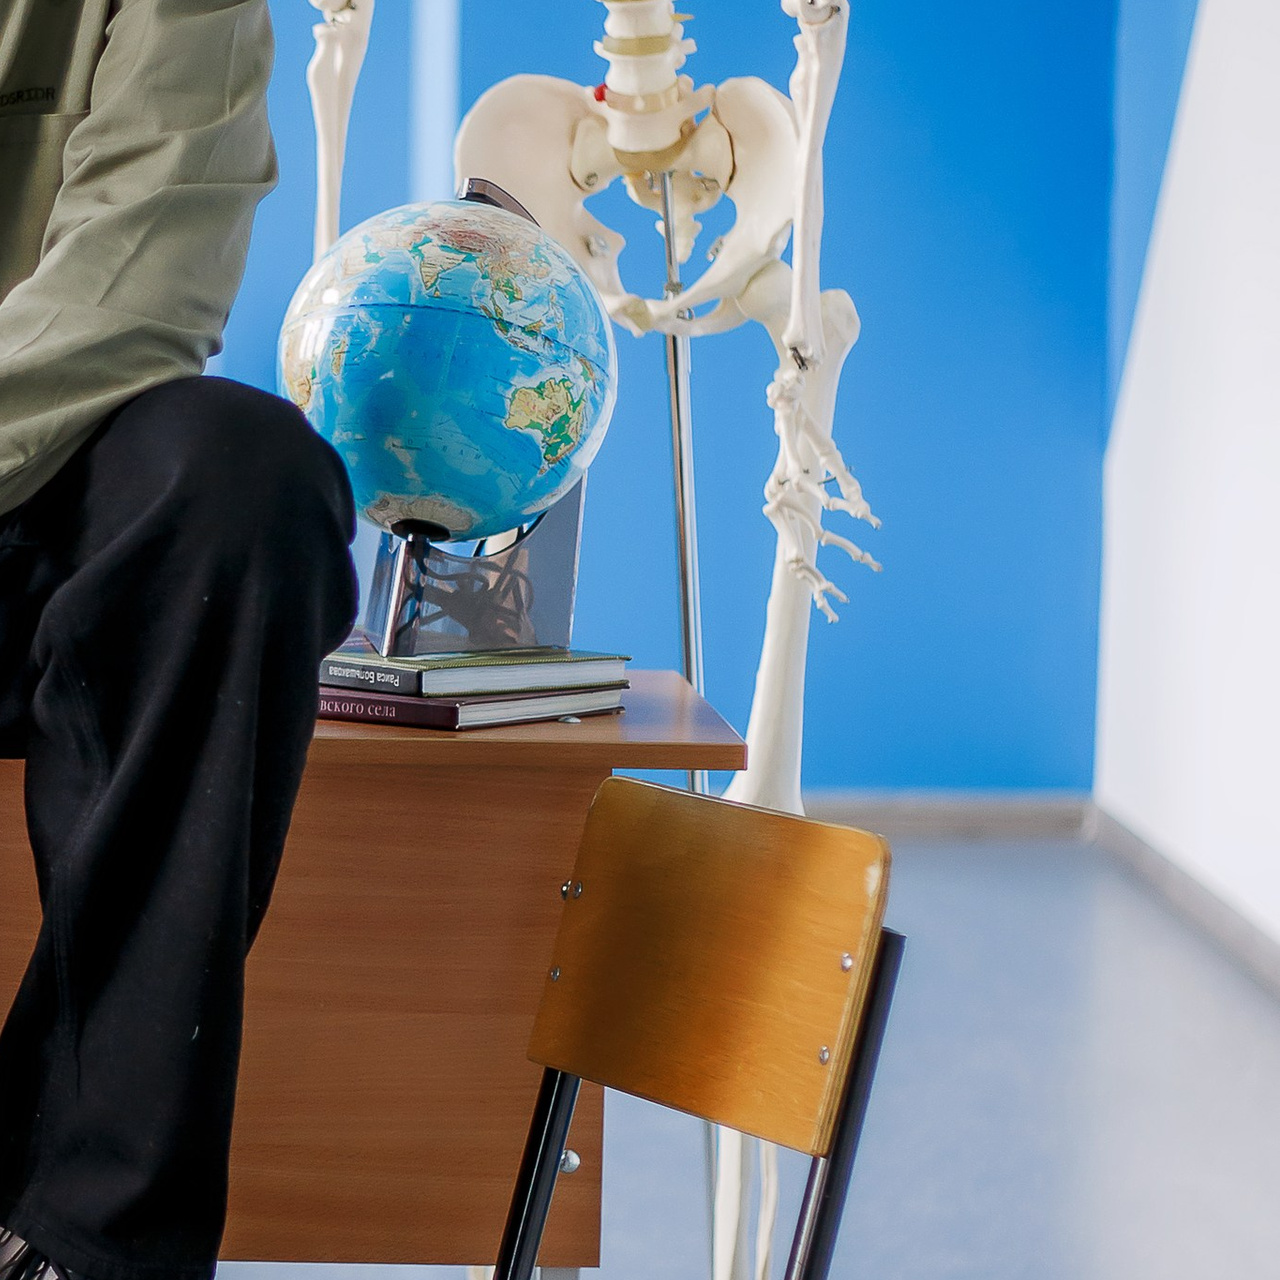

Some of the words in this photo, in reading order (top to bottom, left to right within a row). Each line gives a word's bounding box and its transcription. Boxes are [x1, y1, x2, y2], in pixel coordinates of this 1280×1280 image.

[328, 665, 376, 684] Большакова
[376, 672, 400, 687] Раиса
[320, 700, 365, 714] вского
[368, 704, 397, 718] села
